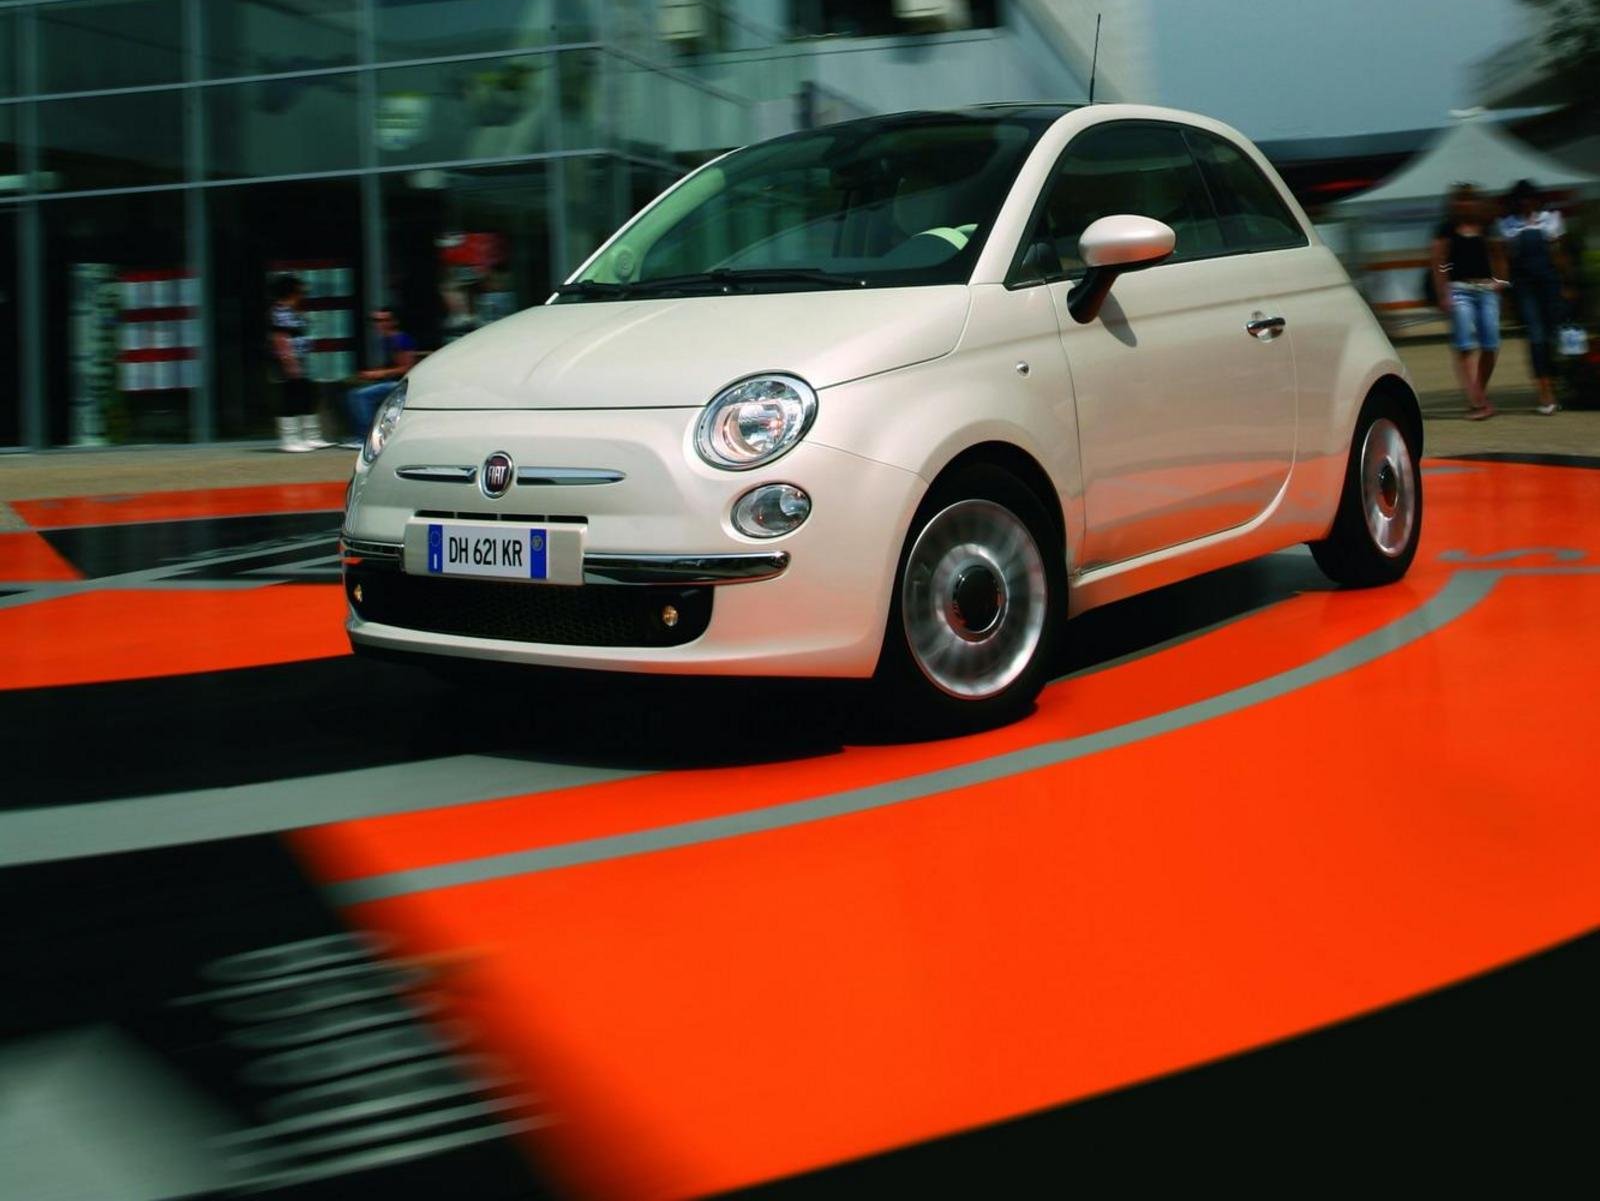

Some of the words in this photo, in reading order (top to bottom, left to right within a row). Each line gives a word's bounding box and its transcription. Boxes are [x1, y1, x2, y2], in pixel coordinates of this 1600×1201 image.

[488, 465, 507, 485] FIAT
[449, 536, 469, 564] DH
[473, 538, 497, 566] 621
[502, 539, 523, 567] KR
